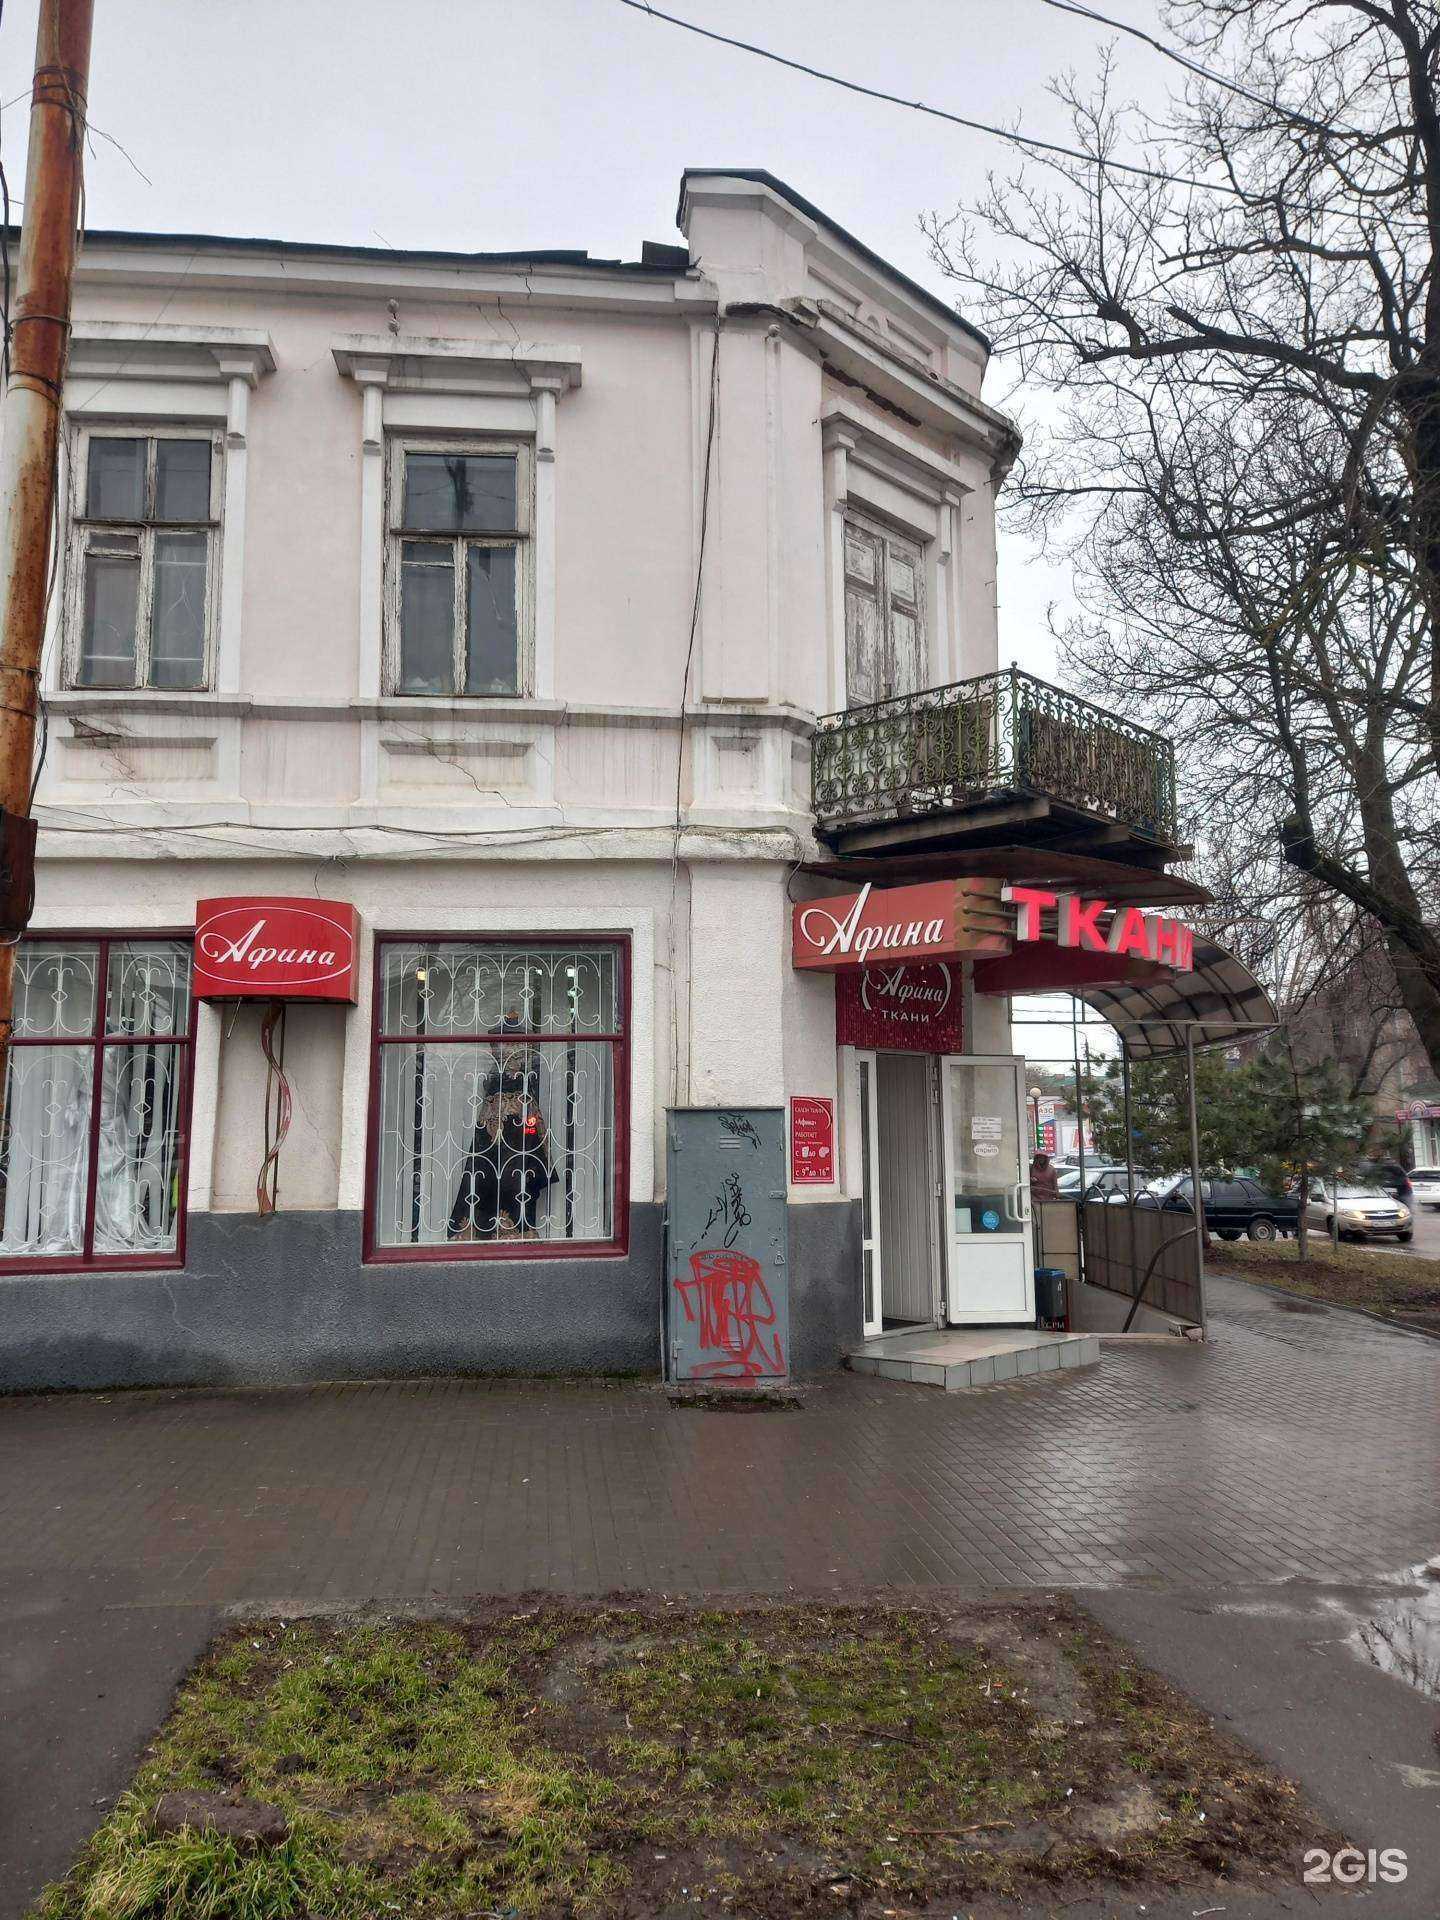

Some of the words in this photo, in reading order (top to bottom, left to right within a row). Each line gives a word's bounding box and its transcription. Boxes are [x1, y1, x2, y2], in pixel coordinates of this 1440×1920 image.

[200, 919, 336, 970] Афина
[800, 882, 945, 963] Афина
[1001, 887, 1194, 972] ТКАНИ
[865, 966, 945, 1004] Афина
[881, 1009, 930, 1023] ТКАНИ
